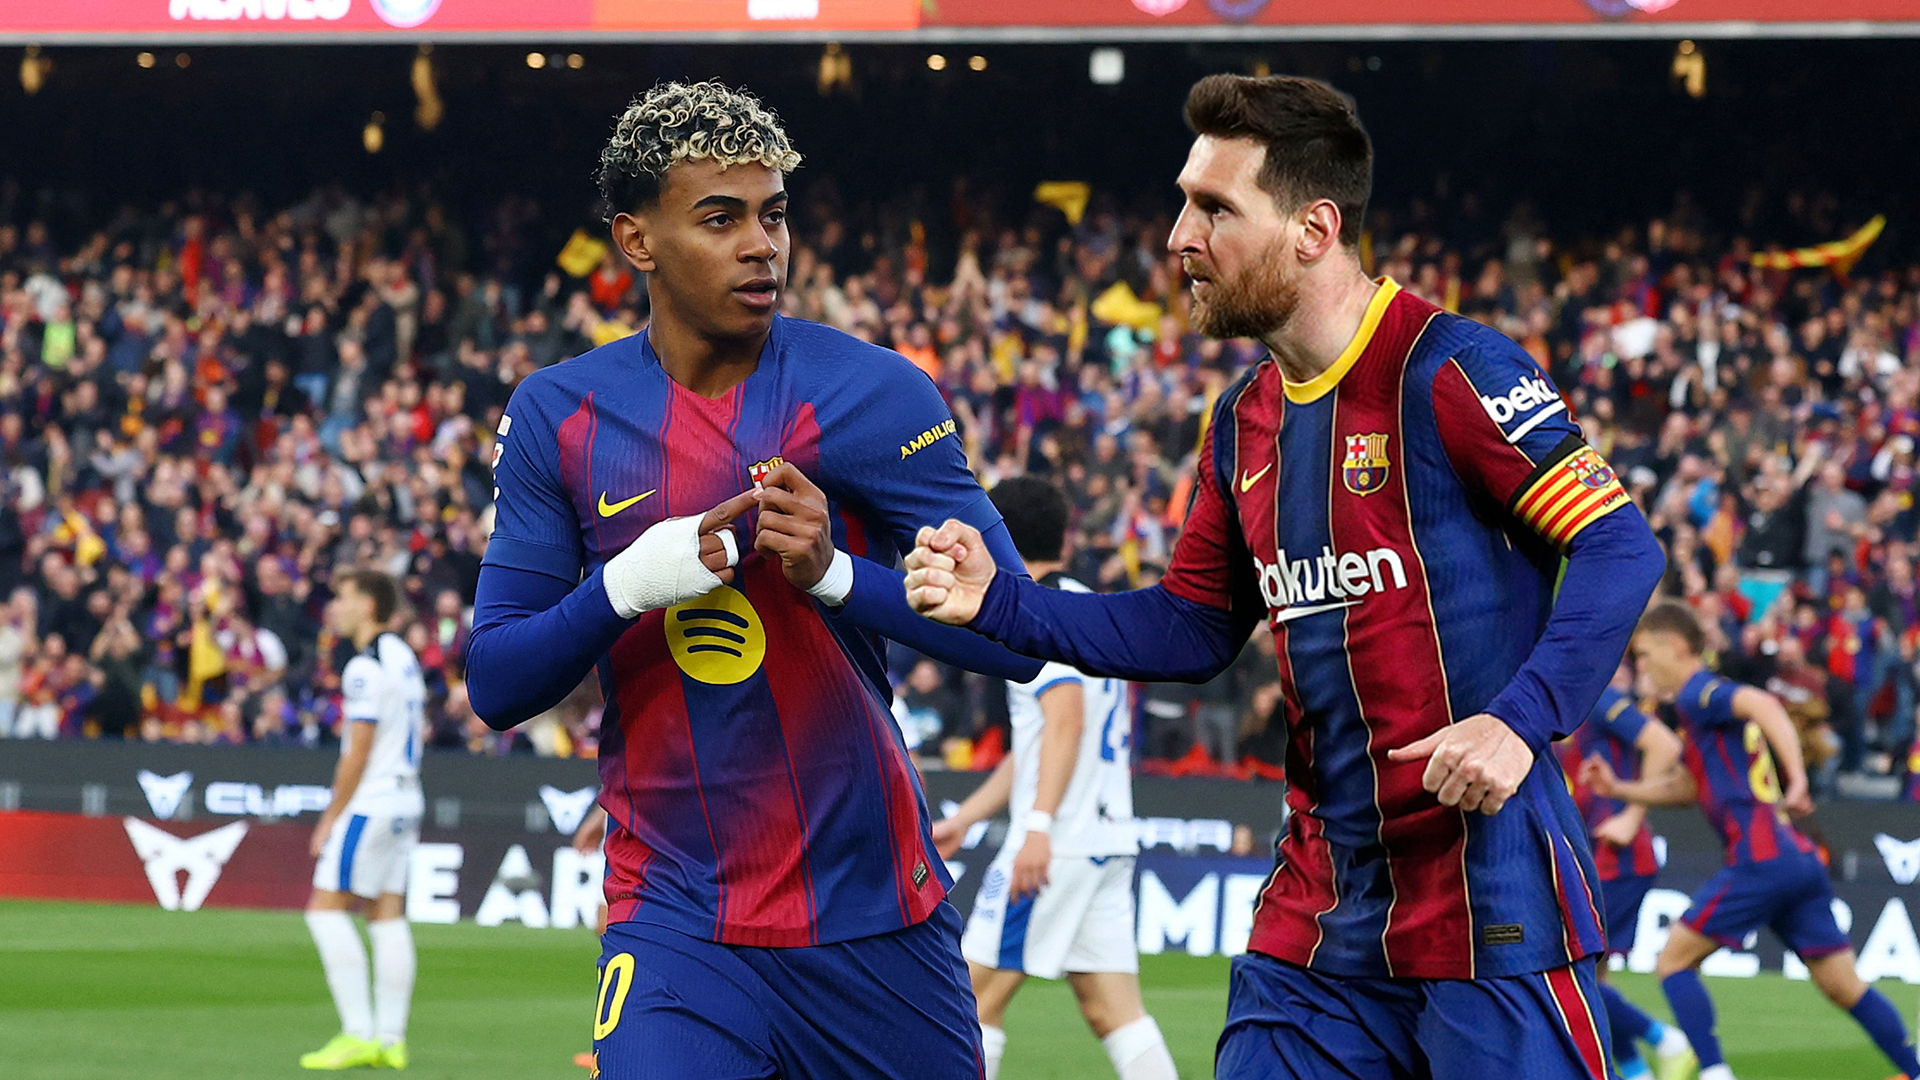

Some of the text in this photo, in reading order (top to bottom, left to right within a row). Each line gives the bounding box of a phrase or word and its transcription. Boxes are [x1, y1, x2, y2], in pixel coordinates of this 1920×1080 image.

[900, 418, 957, 461] AMBILIG
[204, 781, 335, 817] CUP
[592, 951, 636, 1041] 0
